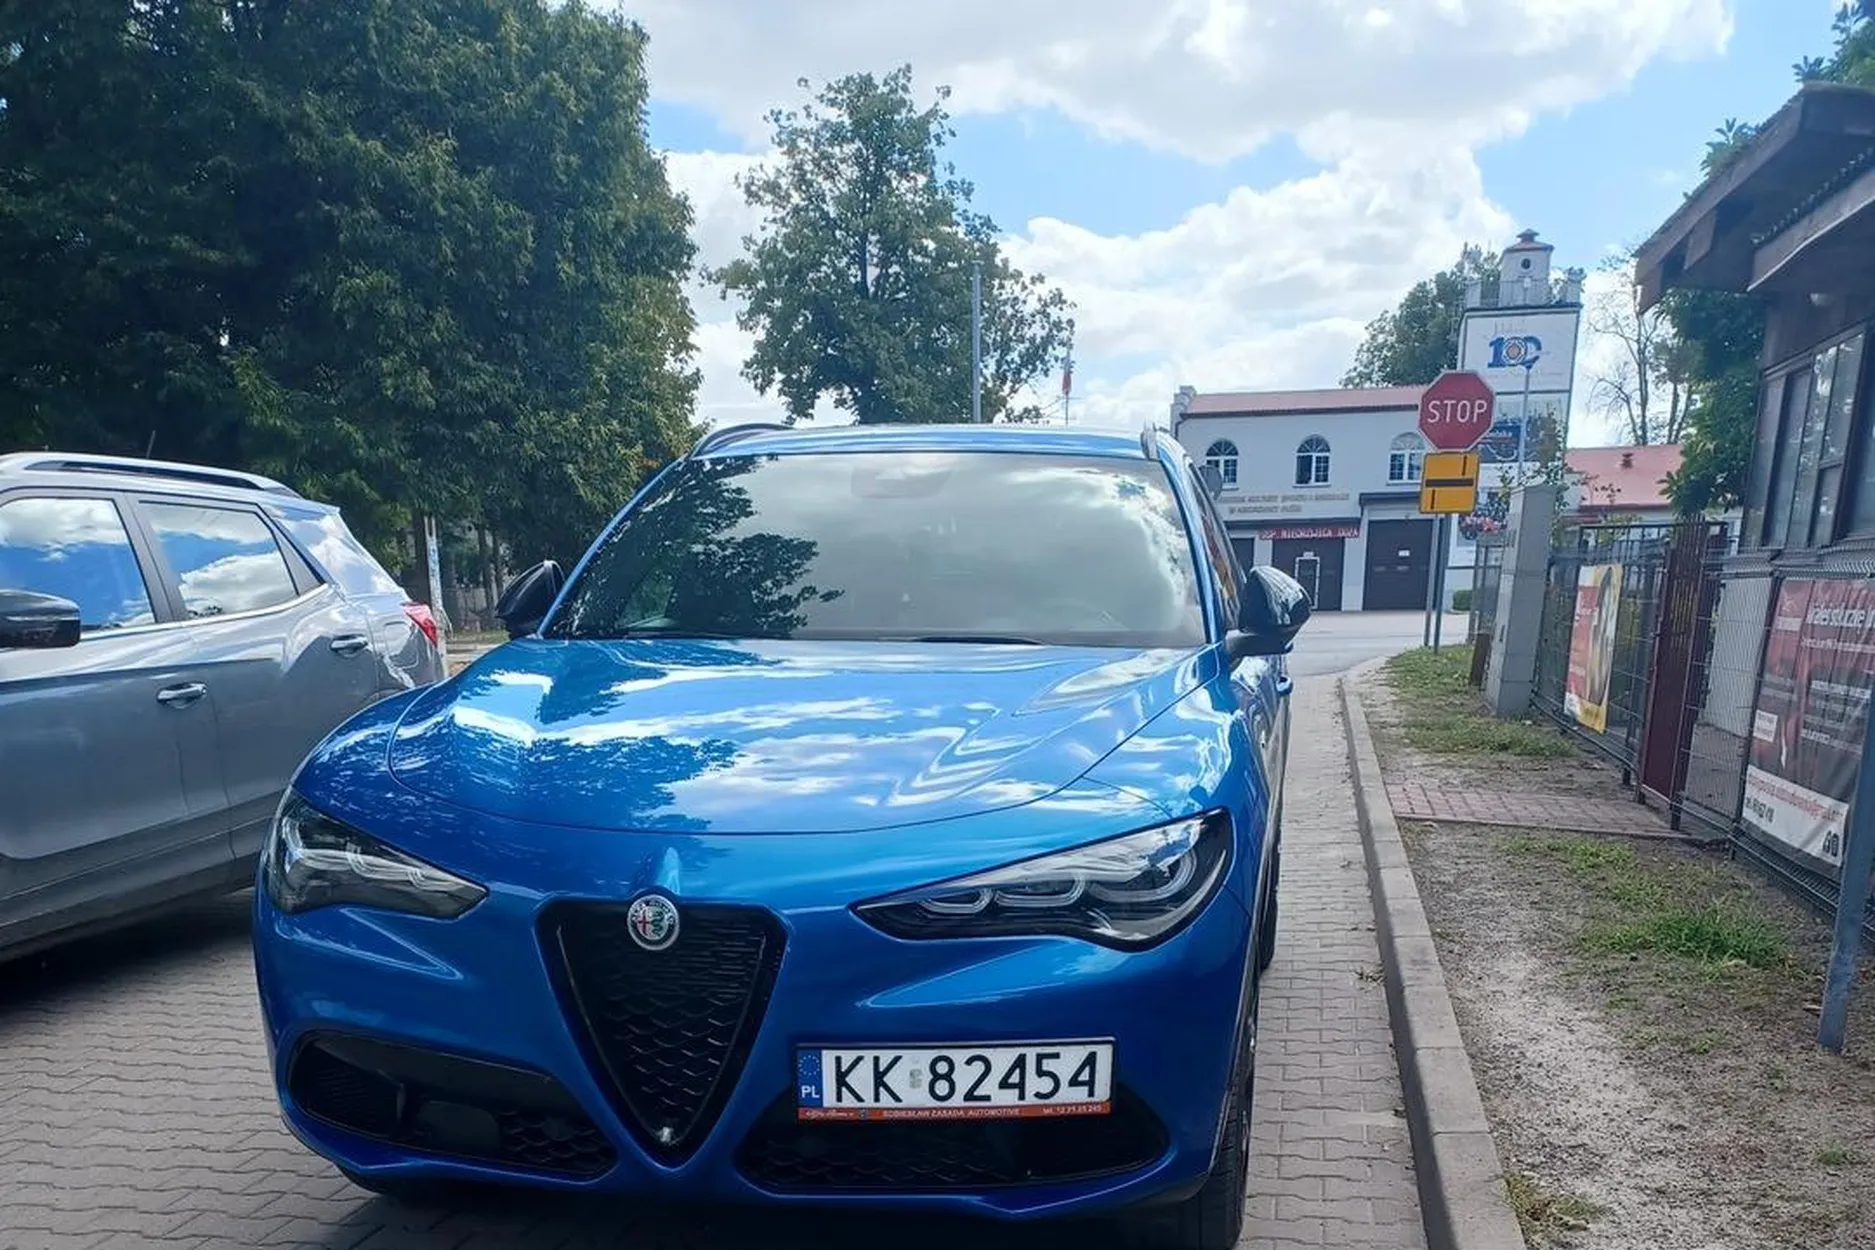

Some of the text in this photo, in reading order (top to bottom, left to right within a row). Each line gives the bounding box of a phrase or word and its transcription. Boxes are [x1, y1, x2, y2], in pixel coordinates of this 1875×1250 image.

[1427, 400, 1488, 423] STOP
[835, 1051, 1098, 1103] KK 82454
[801, 1085, 820, 1099] PL
